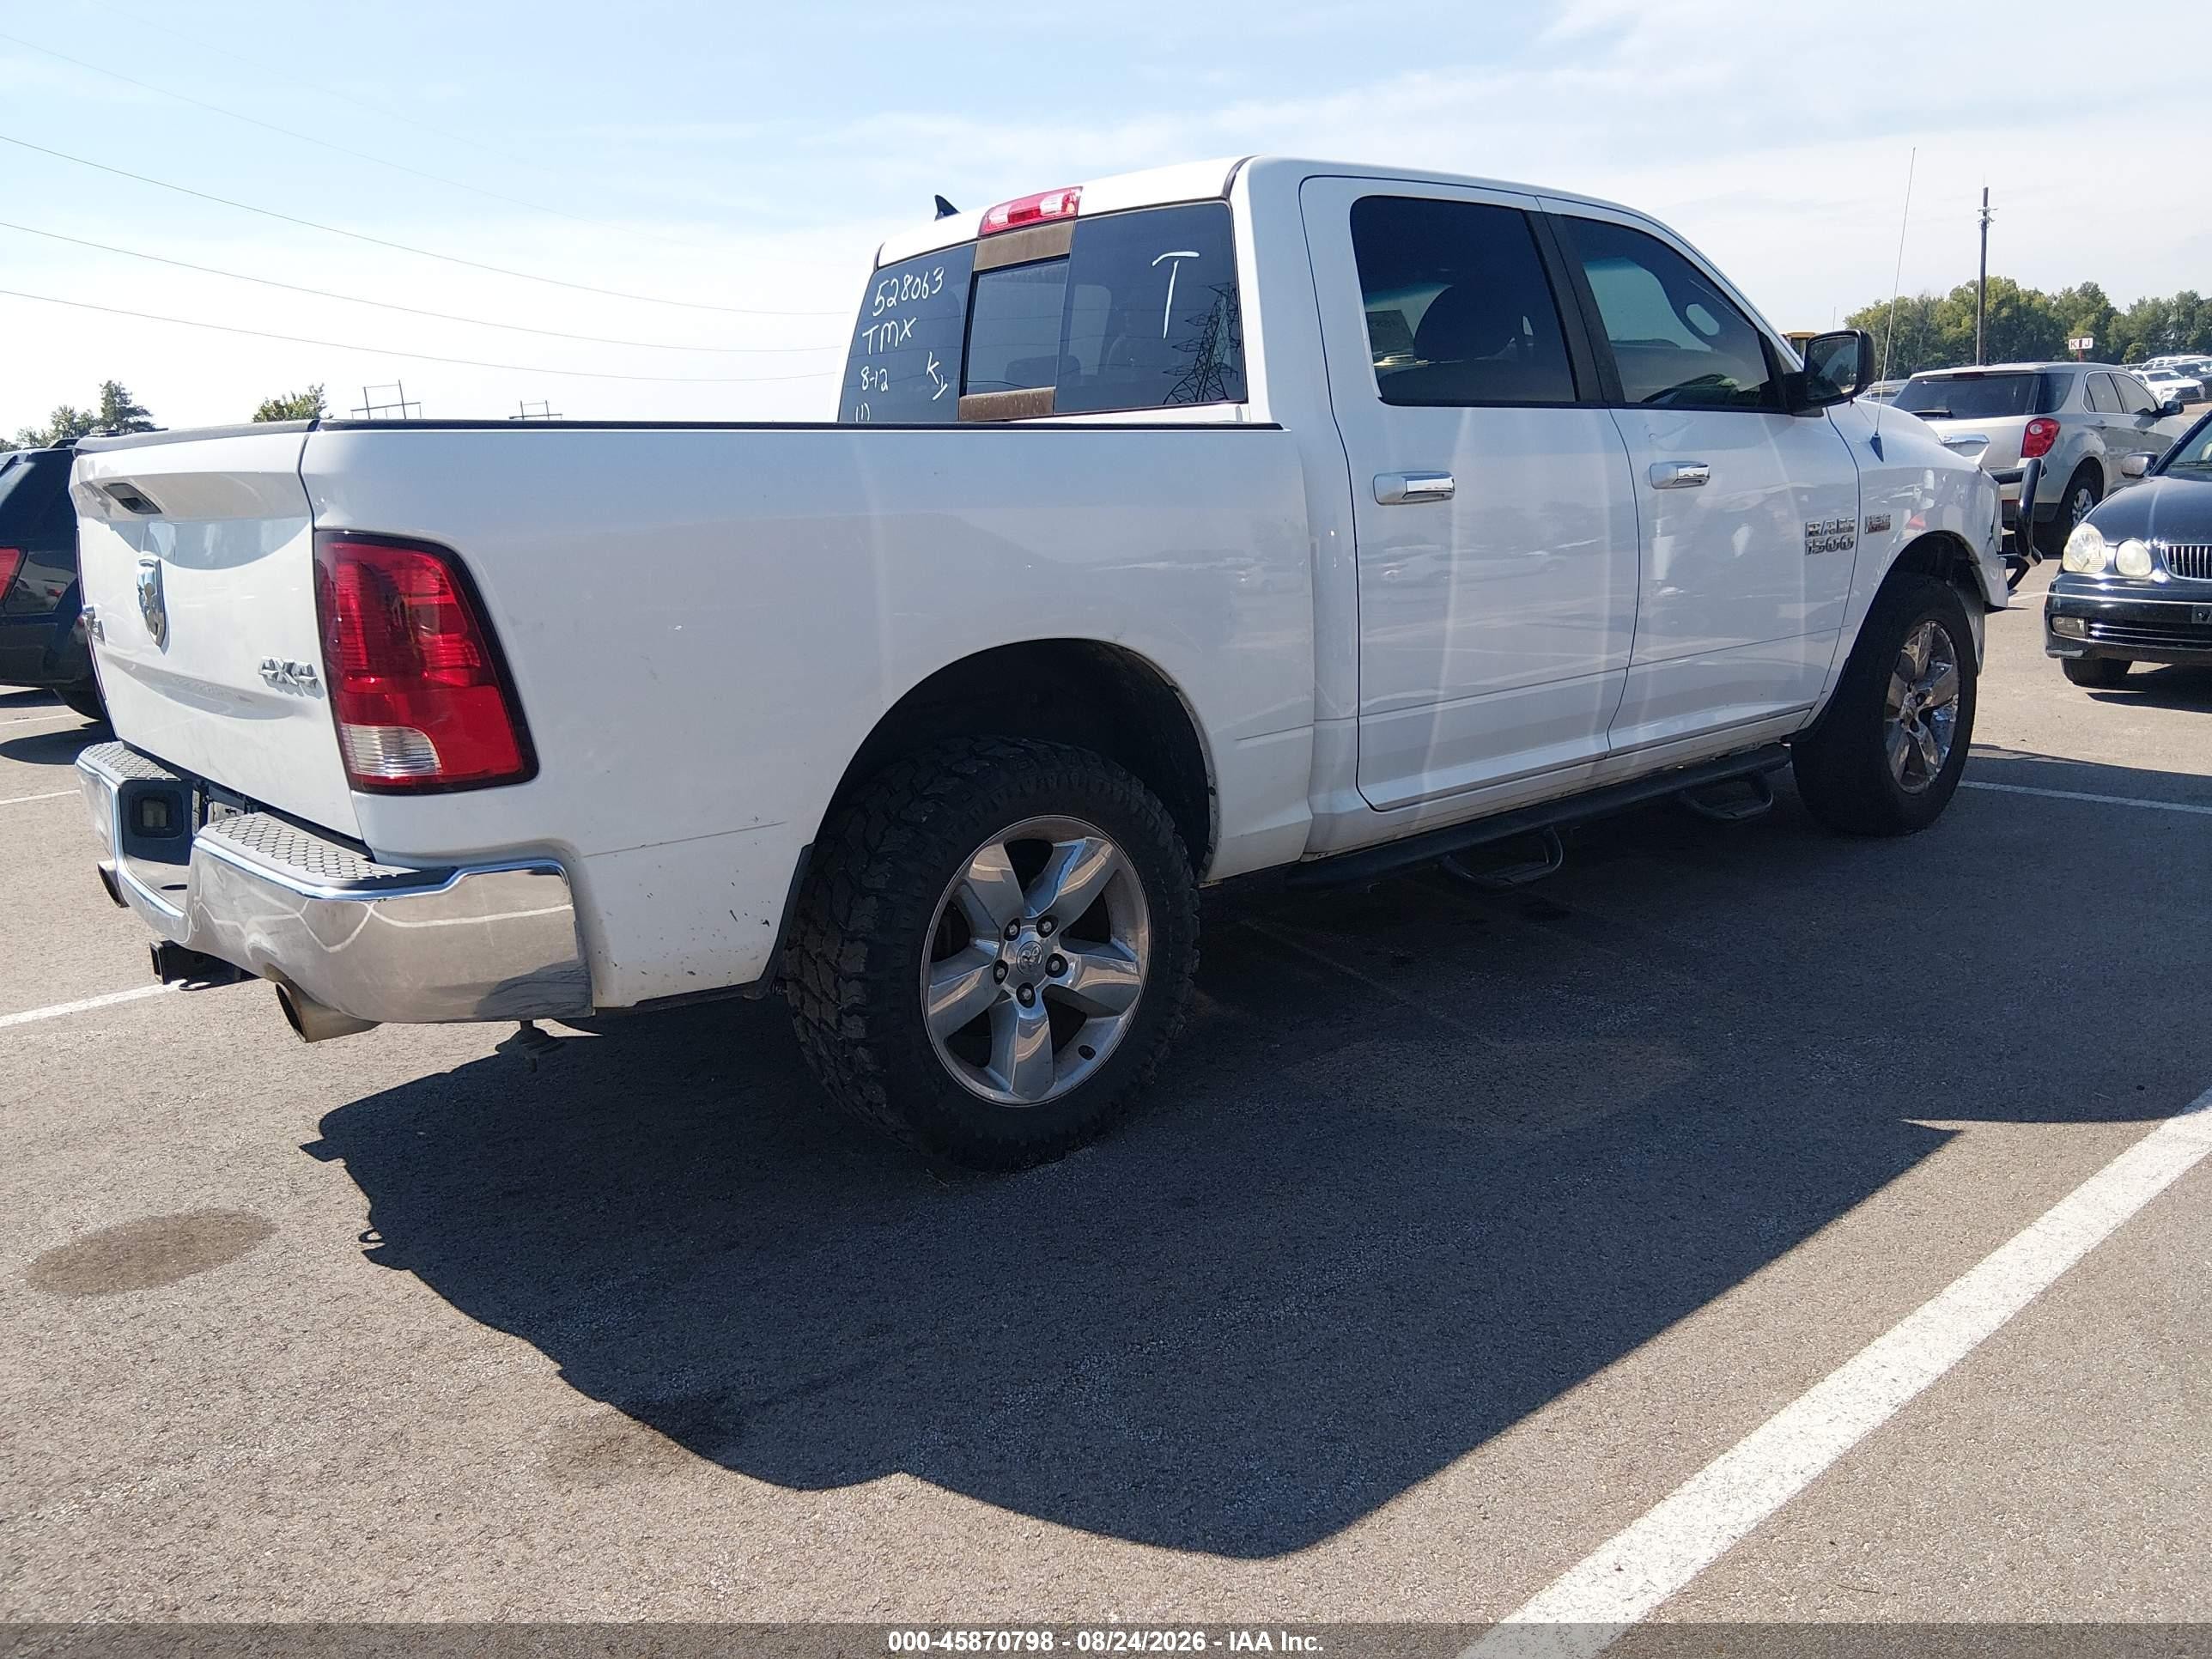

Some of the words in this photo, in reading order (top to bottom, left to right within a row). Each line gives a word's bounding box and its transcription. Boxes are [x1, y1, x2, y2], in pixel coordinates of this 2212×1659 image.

[872, 266, 945, 317] 528063
[1152, 250, 1200, 340] T
[2070, 340, 2078, 349] K
[860, 365, 890, 392] 8-12
[1804, 516, 1856, 538] RAM
[1804, 535, 1855, 556] 1500
